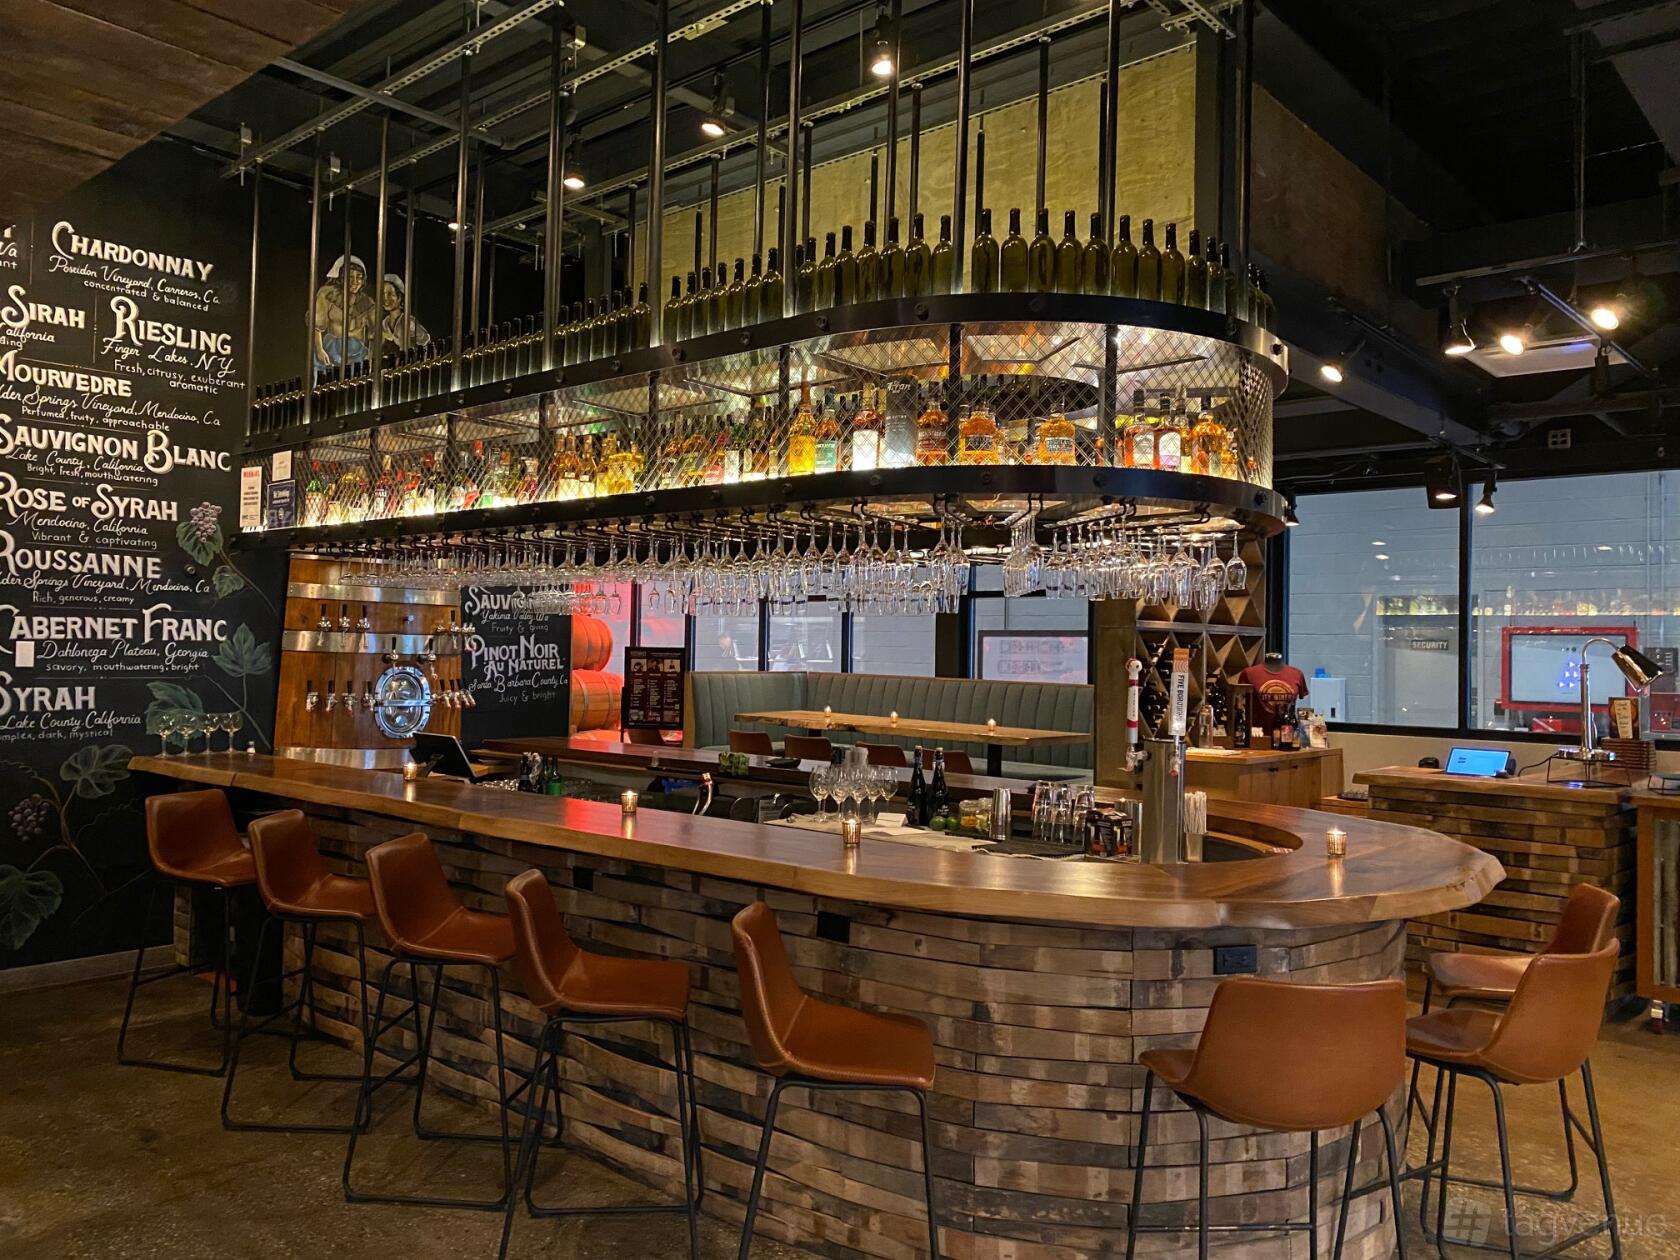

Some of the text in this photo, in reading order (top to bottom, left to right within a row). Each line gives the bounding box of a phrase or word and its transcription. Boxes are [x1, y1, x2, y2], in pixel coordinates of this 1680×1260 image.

[52, 221, 214, 281] CHARDONNAY
[49, 255, 97, 277] Poseidon
[84, 280, 209, 312] concentrated & balanced
[0, 285, 86, 329] SIRAH
[110, 296, 231, 355] RIESLING
[101, 337, 140, 359] Finger
[169, 381, 218, 394] aromatic
[191, 374, 245, 390] exuberant
[22, 385, 78, 412] Springs
[102, 416, 170, 432] approachable
[5, 447, 38, 462] Lake
[94, 456, 145, 476] California
[144, 430, 232, 474] BLANC
[85, 471, 159, 487] mouthwatering
[72, 496, 91, 508] OF
[91, 484, 178, 521] SYRAH
[93, 518, 148, 536] California
[32, 531, 157, 550] Vibrant & captivating
[24, 570, 68, 592] Springs
[103, 595, 135, 605] creamy
[142, 603, 228, 645] FRANC
[481, 609, 511, 624] Yakima
[491, 622, 513, 635] Fruity
[37, 640, 108, 663] Dahlonega
[165, 642, 208, 665] Georgia
[467, 633, 560, 669] PINOT NOIR
[1412, 641, 1448, 649] SECURITY
[171, 663, 200, 673] bright
[484, 658, 564, 682] AU NATUREL
[494, 673, 531, 693] Barbara
[1177, 674, 1185, 689] FIVE
[0, 715, 36, 730] Lake
[85, 711, 141, 729] California
[70, 729, 113, 740] mystical
